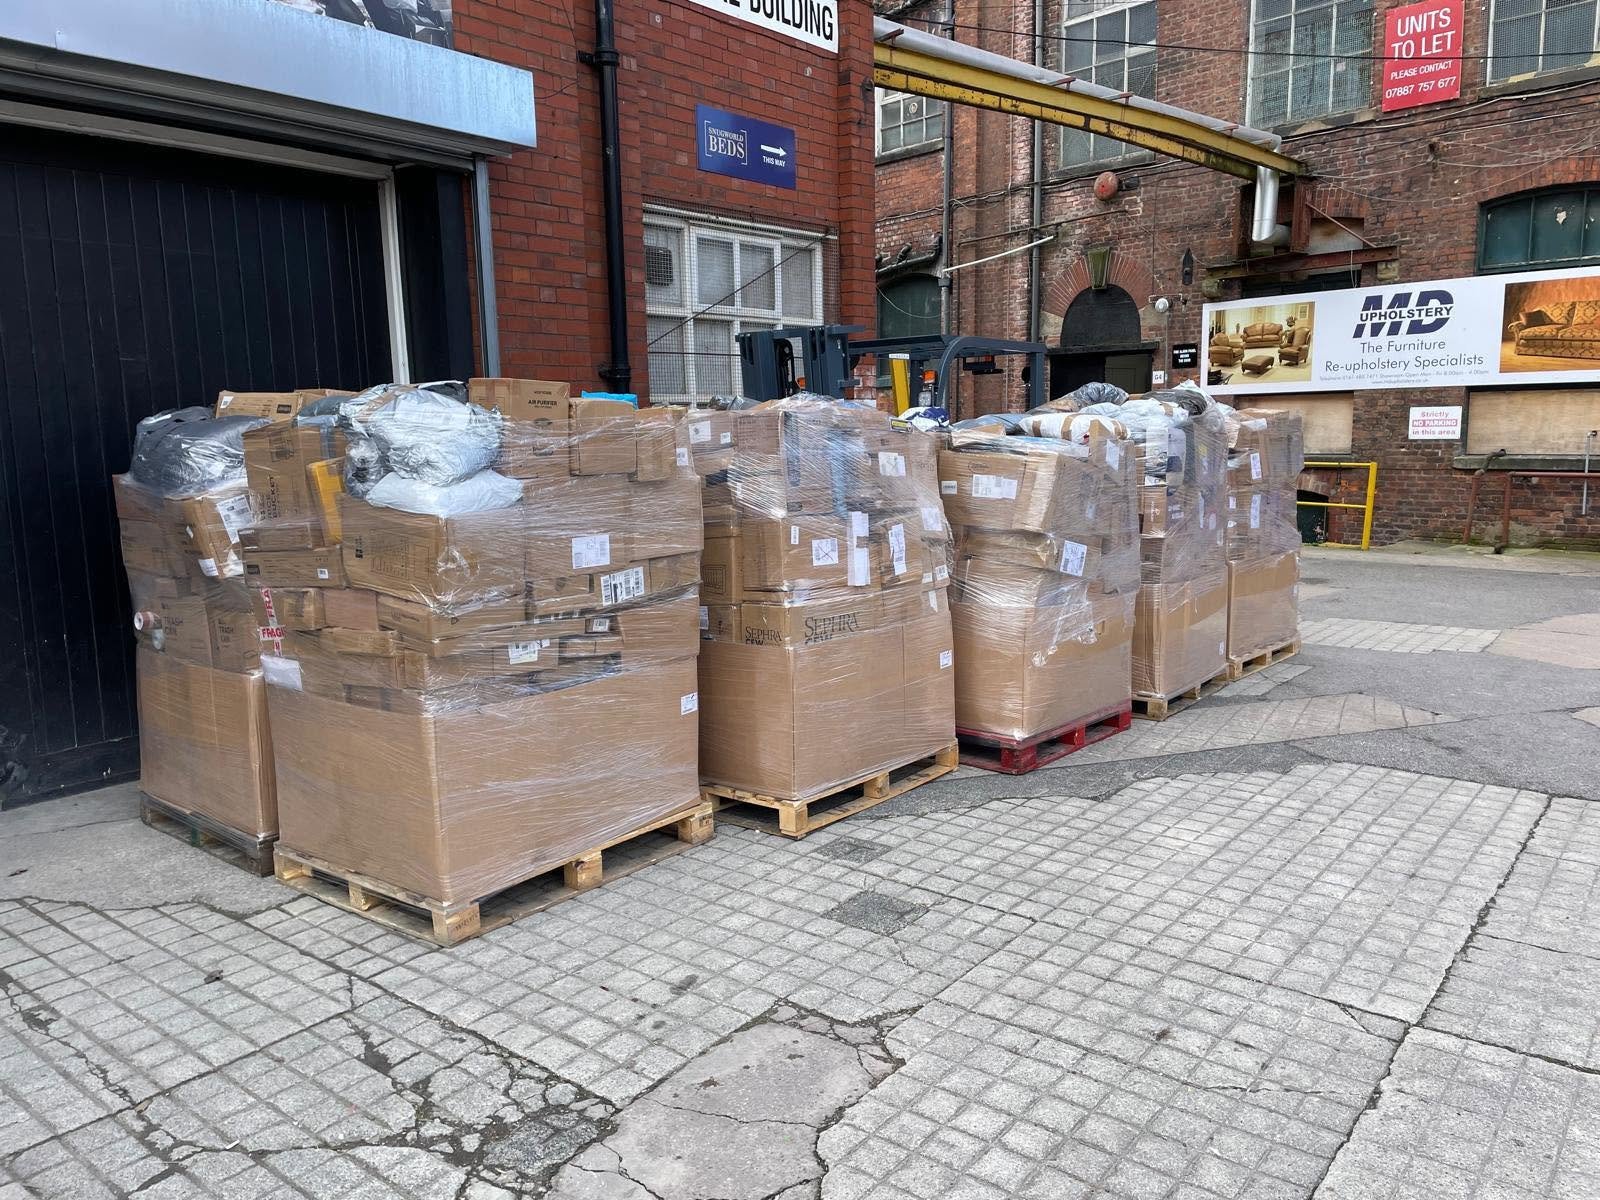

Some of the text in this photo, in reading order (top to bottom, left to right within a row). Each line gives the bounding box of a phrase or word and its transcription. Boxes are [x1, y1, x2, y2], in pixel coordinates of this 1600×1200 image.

[1397, 8, 1451, 37] UNITS
[1391, 31, 1456, 61] TO LET
[1391, 60, 1452, 80] PLEASE CONTACT
[1385, 76, 1457, 99] 07887 757 677
[708, 126, 744, 141] SNUGWORLD
[708, 134, 745, 159] BEDS
[762, 155, 786, 167] THIS WAY
[1352, 289, 1454, 339] MD
[1359, 306, 1454, 322] UPHOLSTERY
[1360, 339, 1446, 354] The Furniture
[1325, 353, 1484, 374] Re-upholstery Specialists
[1425, 419, 1457, 427] PARKING
[745, 625, 783, 642] SEPHRA
[804, 614, 858, 638] SEPHRA
